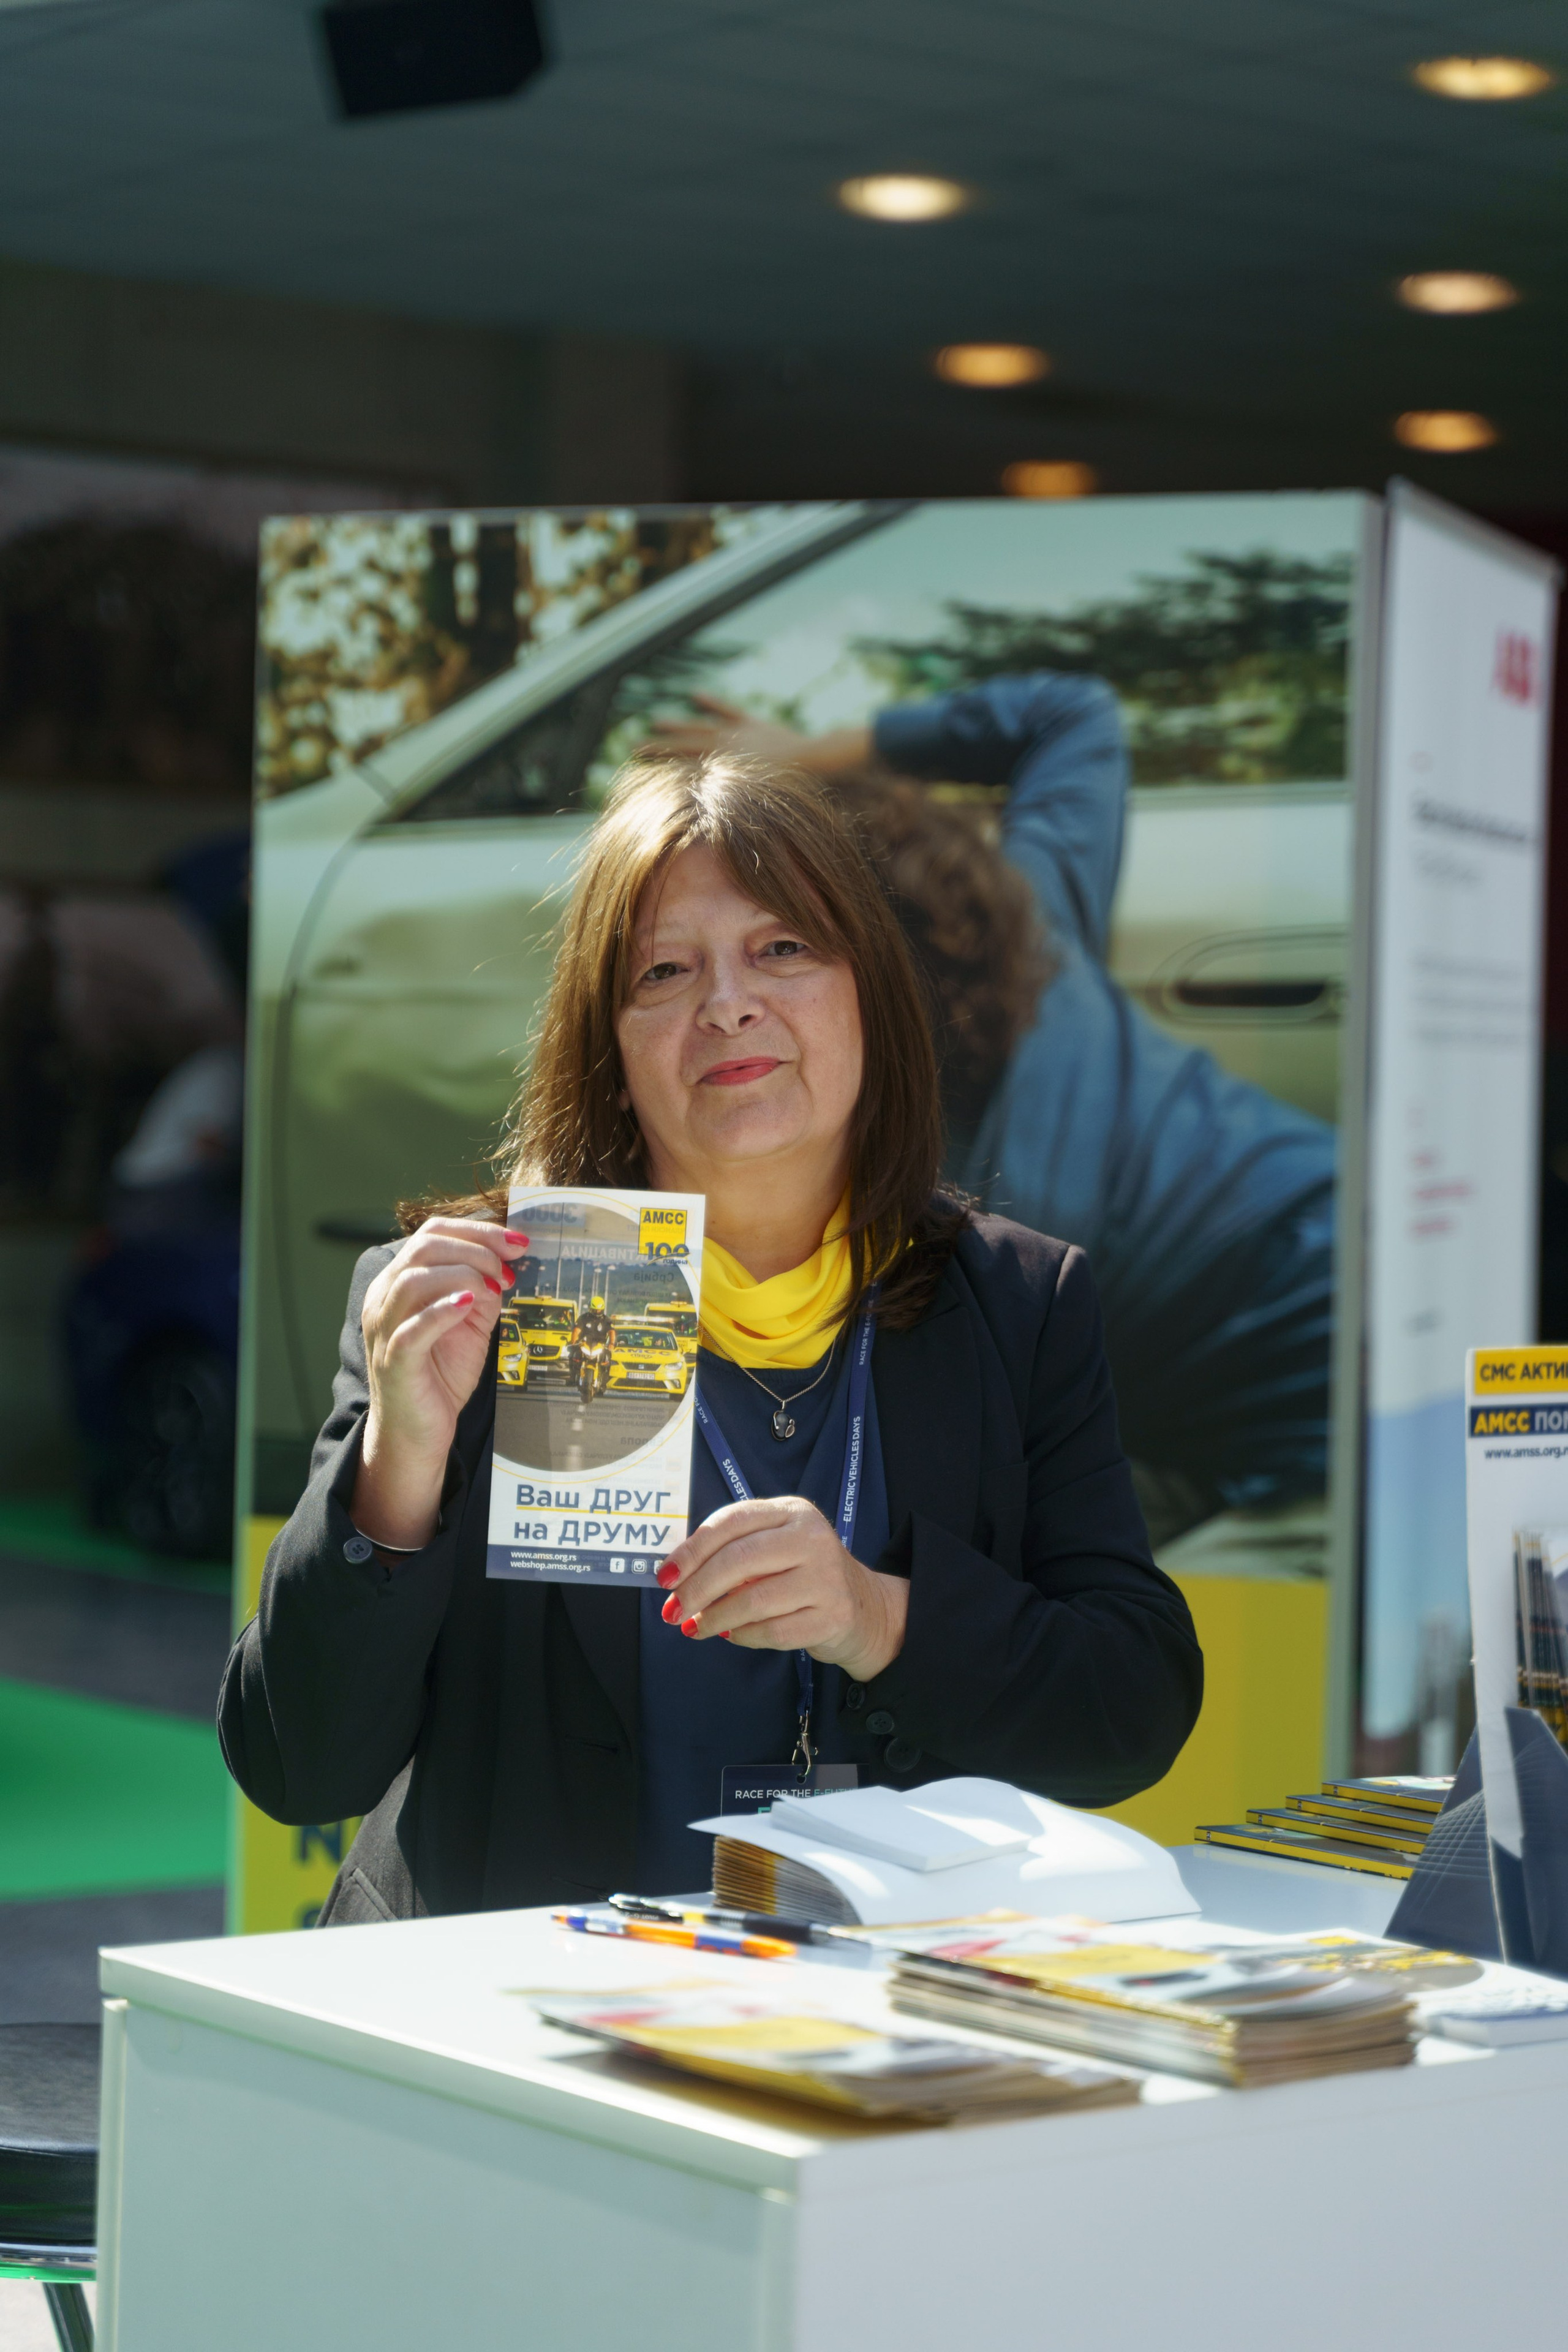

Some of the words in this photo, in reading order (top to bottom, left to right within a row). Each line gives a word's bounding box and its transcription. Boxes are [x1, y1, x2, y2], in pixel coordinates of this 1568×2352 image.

[643, 1210, 684, 1225] АМСС
[645, 1242, 690, 1261] 100
[1480, 1363, 1515, 1381] СМС
[1520, 1362, 1568, 1380] АКТИ
[698, 1406, 708, 1423] RACE
[1474, 1411, 1530, 1433] АМСС
[852, 1416, 861, 1440] DAYS
[849, 1440, 859, 1481] VEHICLES
[723, 1459, 739, 1483] DAYS
[516, 1483, 579, 1508] Ваш
[589, 1488, 671, 1514] ДРУГ
[843, 1482, 856, 1522] ELECTRIC
[514, 1521, 548, 1540] на
[558, 1520, 671, 1546] ДРУМУ
[510, 1560, 591, 1573] webshop.amss.org.rs
[511, 1551, 577, 1562] www.amss.org.rs
[735, 1790, 763, 1799] RACE
[766, 1790, 788, 1798] FOR
[791, 1789, 811, 1798] THE
